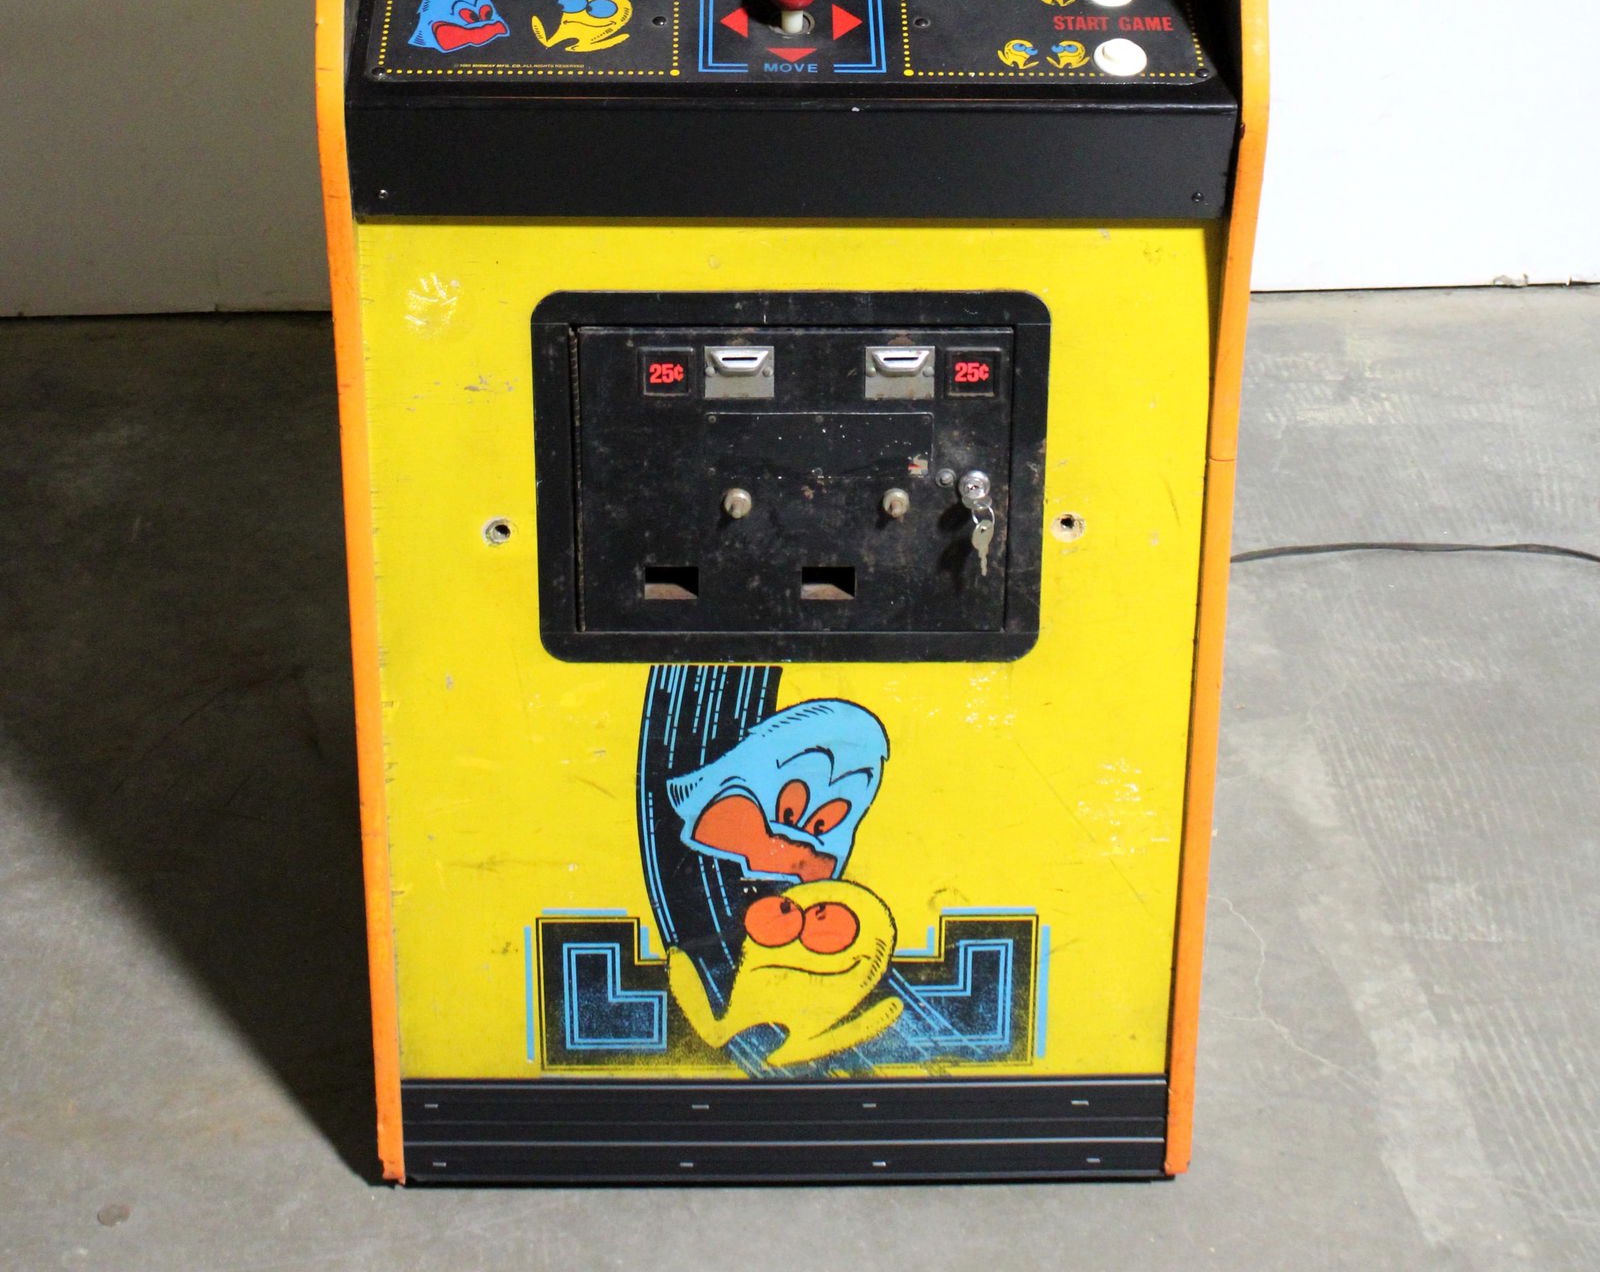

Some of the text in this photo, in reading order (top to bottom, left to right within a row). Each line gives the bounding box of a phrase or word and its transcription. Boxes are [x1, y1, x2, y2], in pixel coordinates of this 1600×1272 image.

[1053, 15, 1174, 32] START GAME
[764, 63, 818, 73] MOVE
[649, 363, 684, 384] 25¢
[954, 361, 989, 383] 25¢
